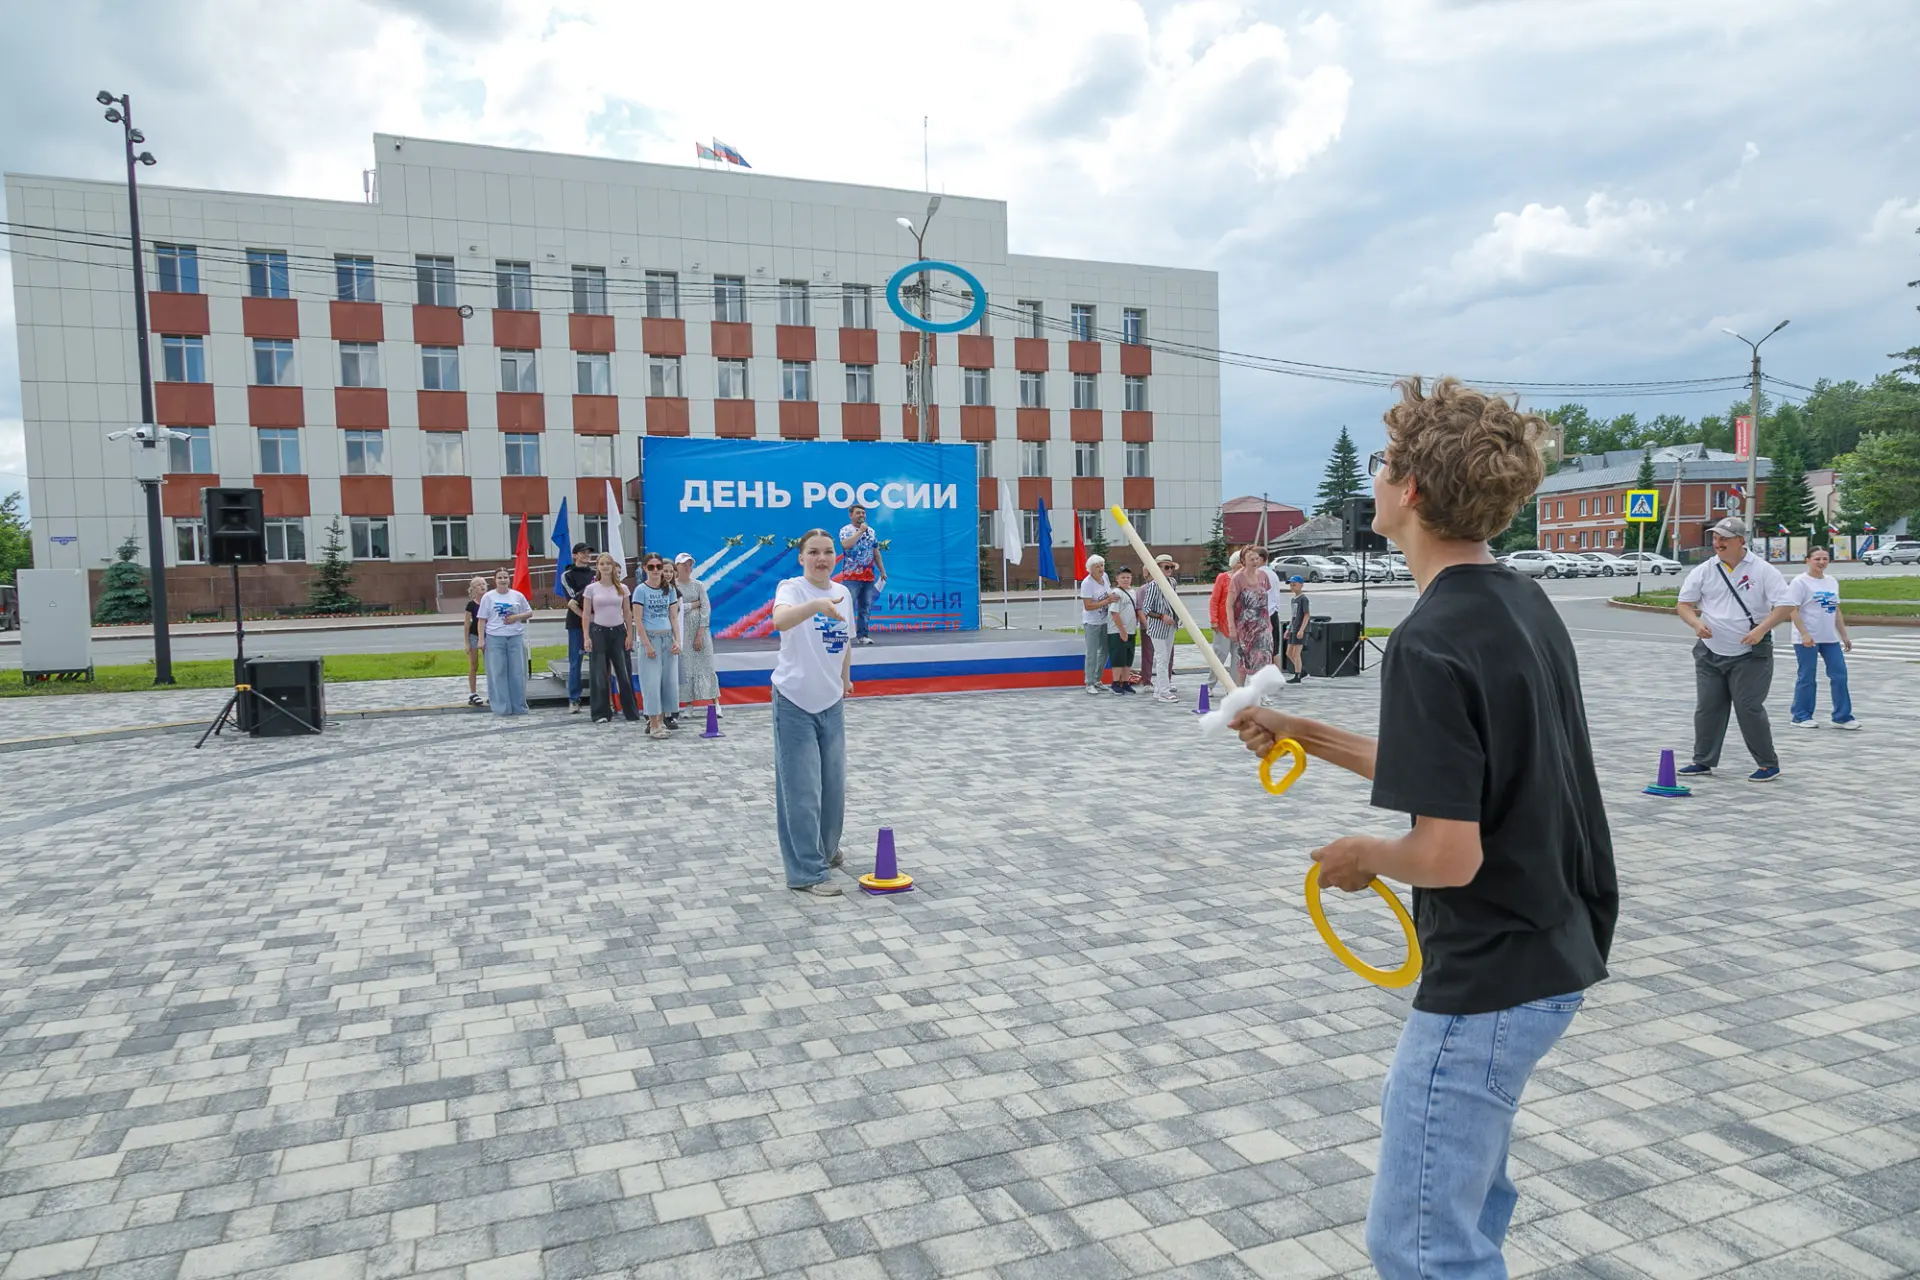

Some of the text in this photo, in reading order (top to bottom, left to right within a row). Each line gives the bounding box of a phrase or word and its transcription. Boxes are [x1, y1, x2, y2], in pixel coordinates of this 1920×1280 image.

[680, 480, 957, 512] ДЕНЬ РОССИИ
[888, 591, 962, 611] ИЮНЯ
